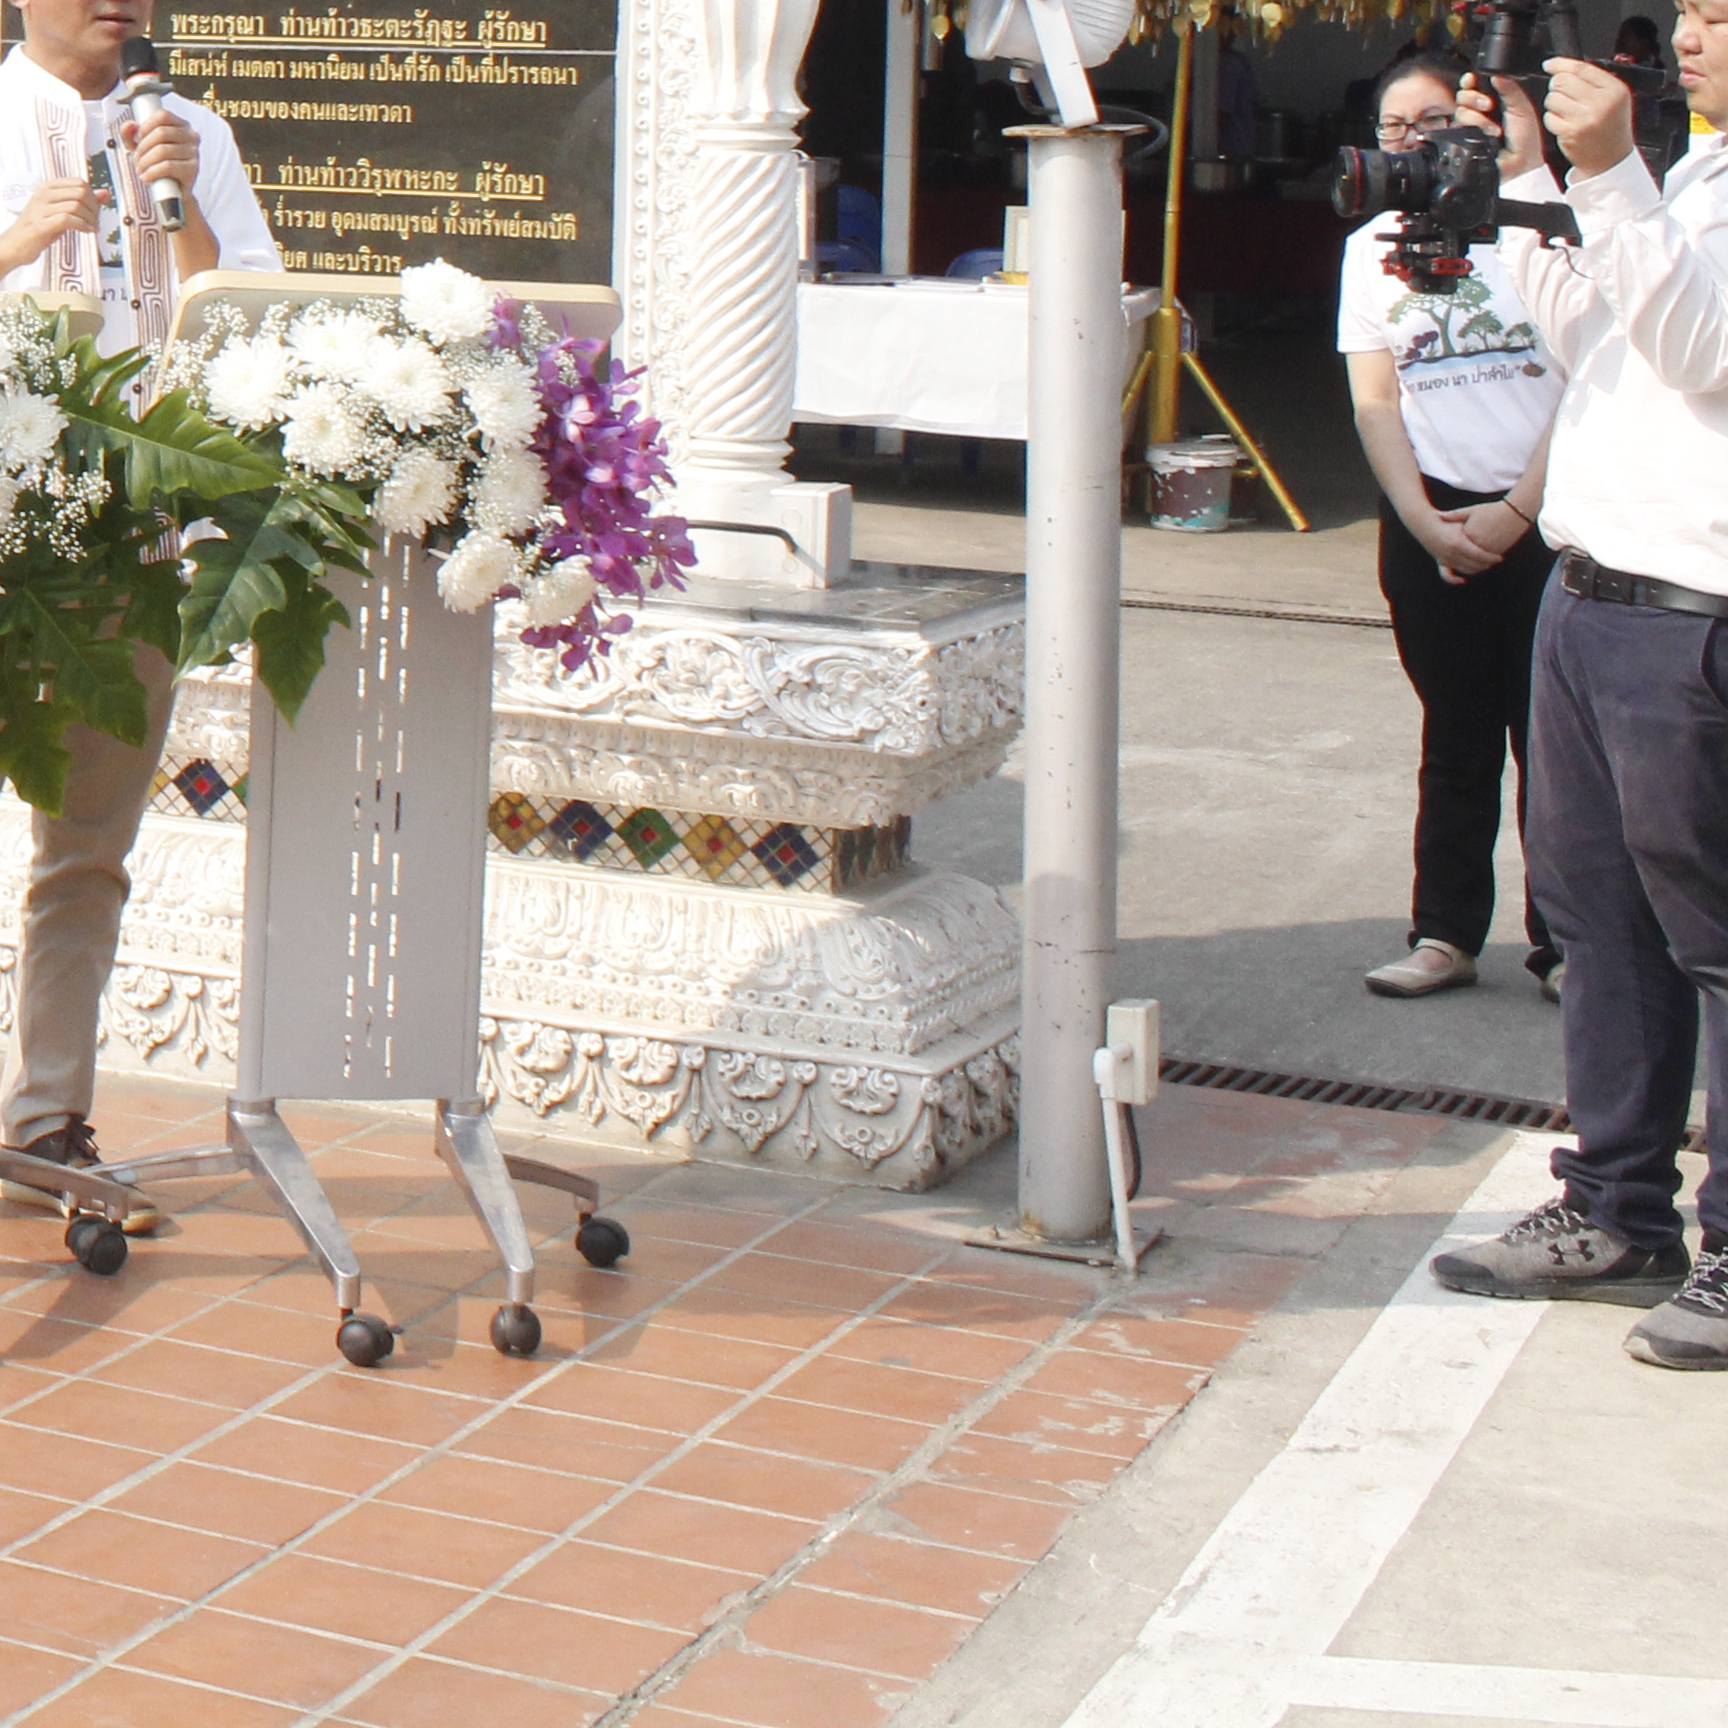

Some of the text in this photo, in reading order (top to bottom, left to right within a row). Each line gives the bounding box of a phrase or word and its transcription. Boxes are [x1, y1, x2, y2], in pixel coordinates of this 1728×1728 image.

[170, 12, 265, 43] พระกรุณา
[477, 9, 549, 49] ผู้รักษา
[168, 49, 580, 85] มีเสน่ห์ เมตตา มหานิยม เป็นที่รัก เป็นที่ปรารถนา
[475, 160, 547, 201] ผู้รักษา
[273, 194, 327, 229] ร่ำรวย
[330, 205, 440, 241] อุดมสมบูรณ์
[442, 200, 579, 241] ทั้งทรัพย์สมบัติ
[311, 245, 404, 273] และบริวาร
[1452, 373, 1468, 386] นา
